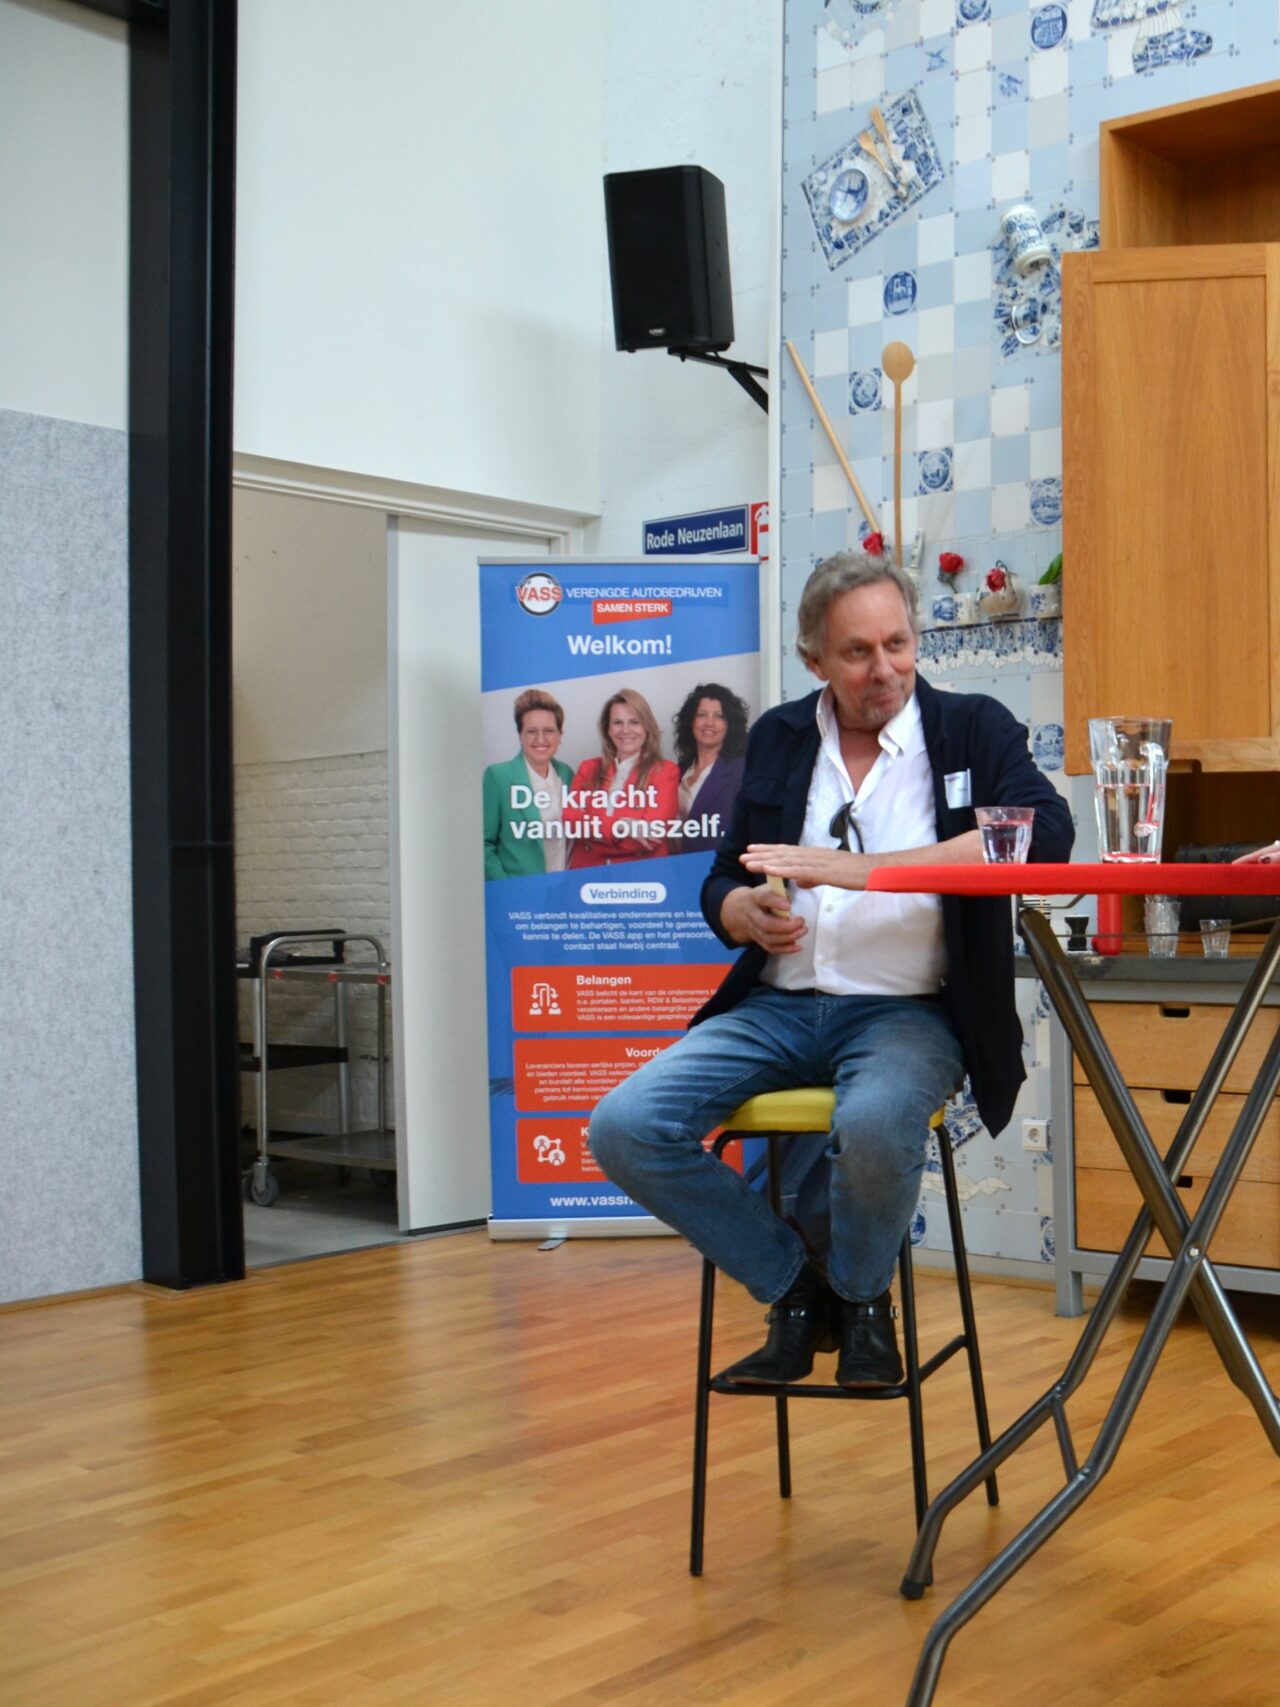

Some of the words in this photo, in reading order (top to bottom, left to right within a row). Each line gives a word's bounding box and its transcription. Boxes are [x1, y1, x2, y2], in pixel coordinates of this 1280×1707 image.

[646, 529, 675, 550] Rode
[677, 520, 743, 545] Neuzenlaan
[515, 585, 563, 601] VASS
[566, 587, 629, 599] VERENIGDE
[631, 586, 722, 598] AUTOBEDRIJVEN
[596, 602, 633, 613] SAMEN
[635, 602, 669, 613] STERK
[567, 634, 672, 655] Welkom!
[510, 785, 549, 810] De
[561, 784, 658, 810] kracht
[510, 815, 602, 840] vanuit
[590, 888, 657, 901] Verbinding
[508, 911, 531, 920] VASS
[533, 911, 567, 920] verbindt
[569, 911, 617, 919] kwalitatieve
[618, 910, 672, 919] ondernemers
[686, 910, 704, 919] leve
[531, 921, 568, 932] belangen
[570, 922, 579, 930] te
[628, 921, 663, 929] voordeel
[665, 921, 674, 929] te
[522, 931, 549, 940] kennis
[551, 932, 560, 940] te
[588, 931, 601, 940] De
[602, 931, 626, 940] VASS
[627, 932, 644, 941] app
[657, 931, 670, 939] het
[564, 942, 594, 951] contact
[596, 942, 617, 950] staat
[618, 941, 644, 952] hierbij
[576, 974, 632, 987] Belangen
[625, 1047, 664, 1057] Voord
[550, 1195, 637, 1207] www.vassn
